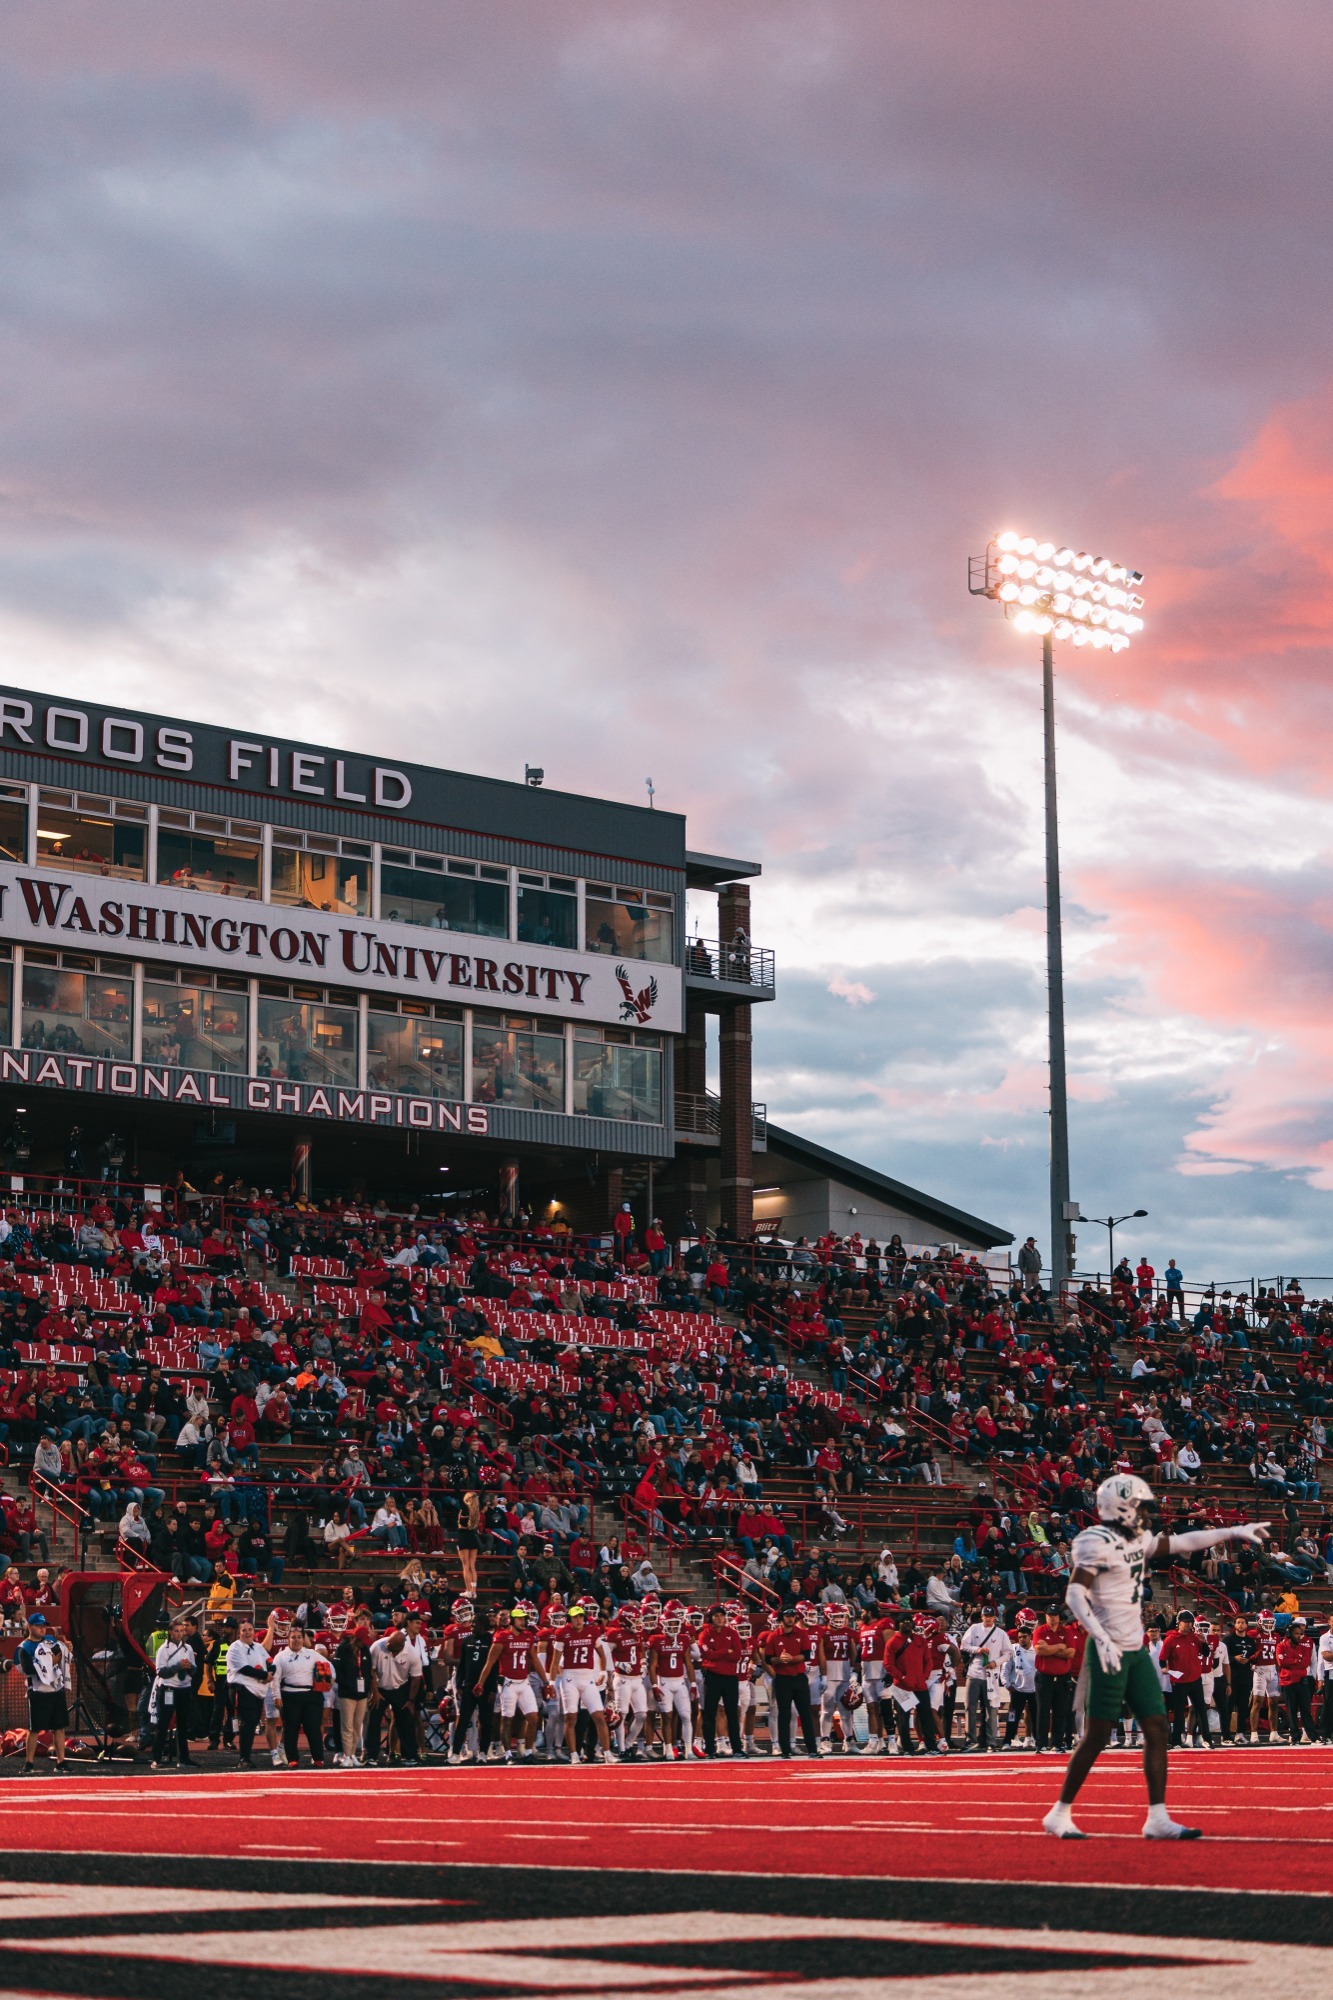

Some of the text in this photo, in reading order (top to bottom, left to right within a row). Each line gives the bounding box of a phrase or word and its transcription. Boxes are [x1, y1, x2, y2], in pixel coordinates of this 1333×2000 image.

[0, 696, 412, 809] ROOS FIELD
[16, 877, 330, 967] WASHINGTON
[339, 929, 591, 1004] UNIVERSITY
[2, 1051, 489, 1134] NATIONAL CHAMPIONS
[754, 1222, 778, 1232] Blitz
[473, 1651, 480, 1661] 3
[513, 1650, 527, 1670] 14
[573, 1647, 588, 1664] 12
[630, 1645, 637, 1665] 8
[669, 1652, 677, 1669] 6
